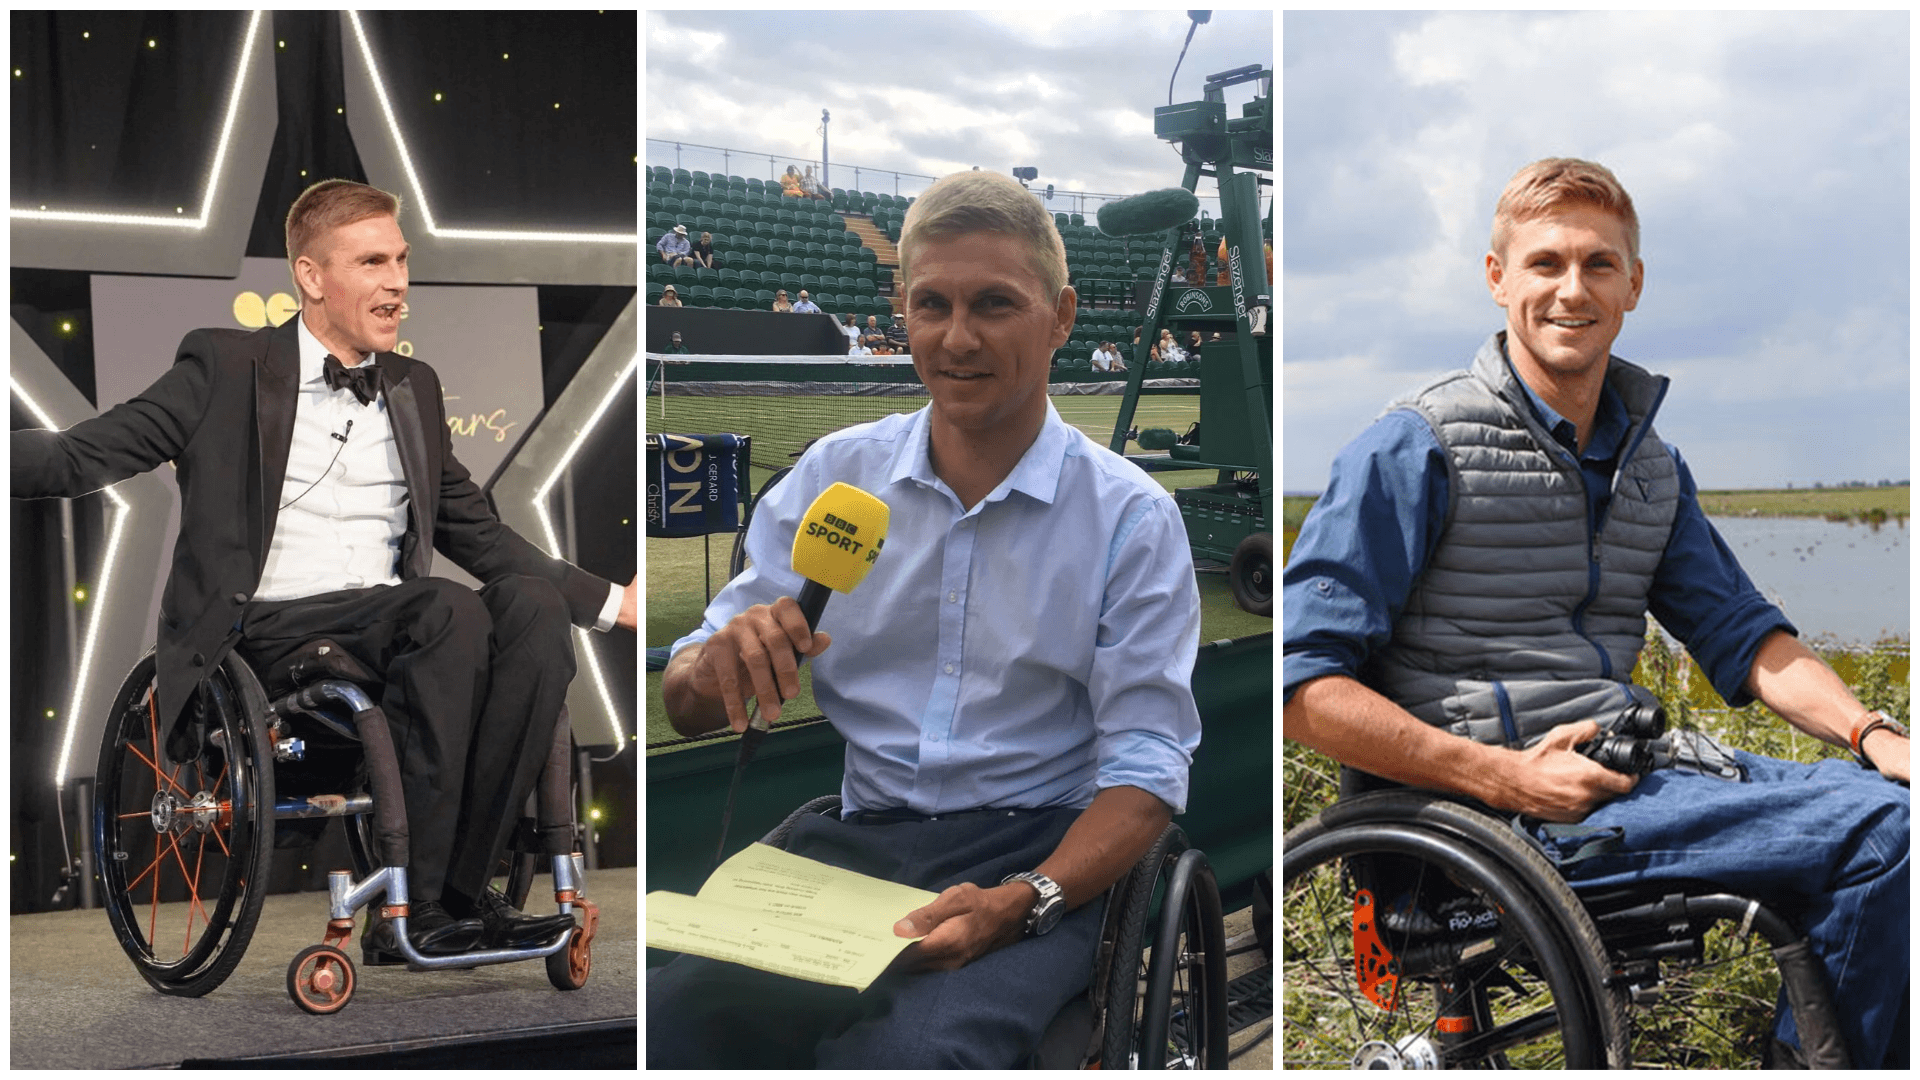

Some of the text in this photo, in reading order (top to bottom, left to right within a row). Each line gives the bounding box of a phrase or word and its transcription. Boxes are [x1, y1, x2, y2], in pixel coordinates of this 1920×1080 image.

[1147, 247, 1173, 320] Slazenger
[1179, 291, 1210, 309] ROBINSONS
[1228, 245, 1248, 319] Slazenger
[708, 463, 718, 502] GERARD
[806, 522, 863, 555] SPORT
[823, 512, 858, 536] BBC
